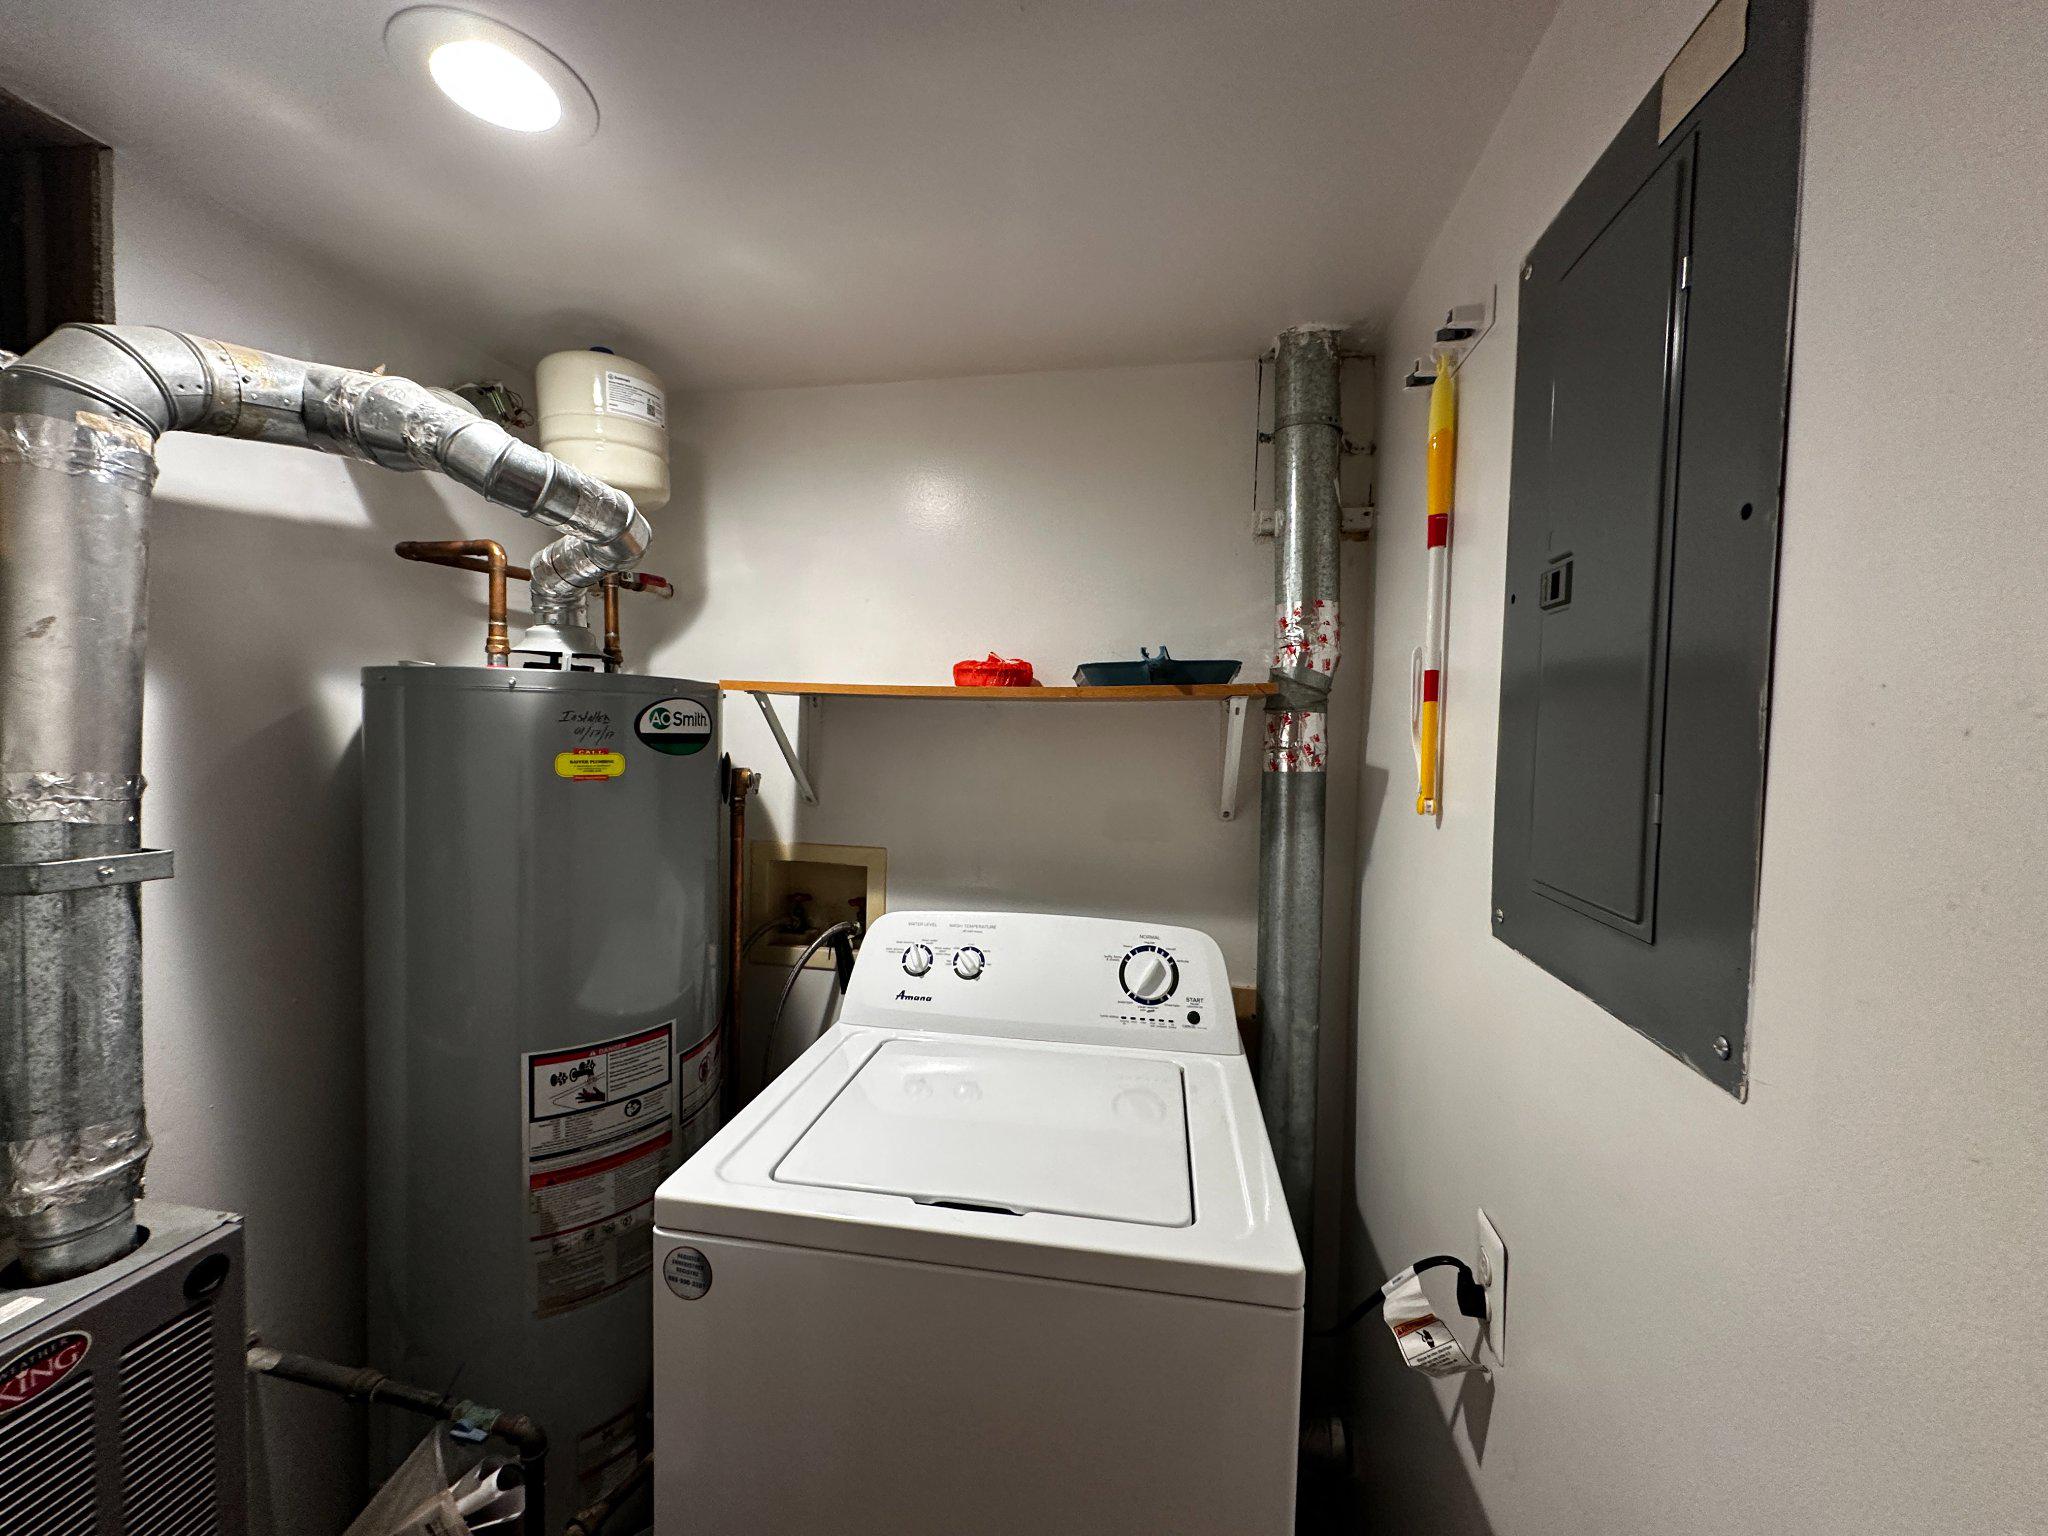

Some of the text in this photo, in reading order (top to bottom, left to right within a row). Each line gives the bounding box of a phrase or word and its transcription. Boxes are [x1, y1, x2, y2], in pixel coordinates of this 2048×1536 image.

[673, 711, 707, 727] Smith
[895, 989, 932, 1002] Amana
[1185, 996, 1204, 1004] START
